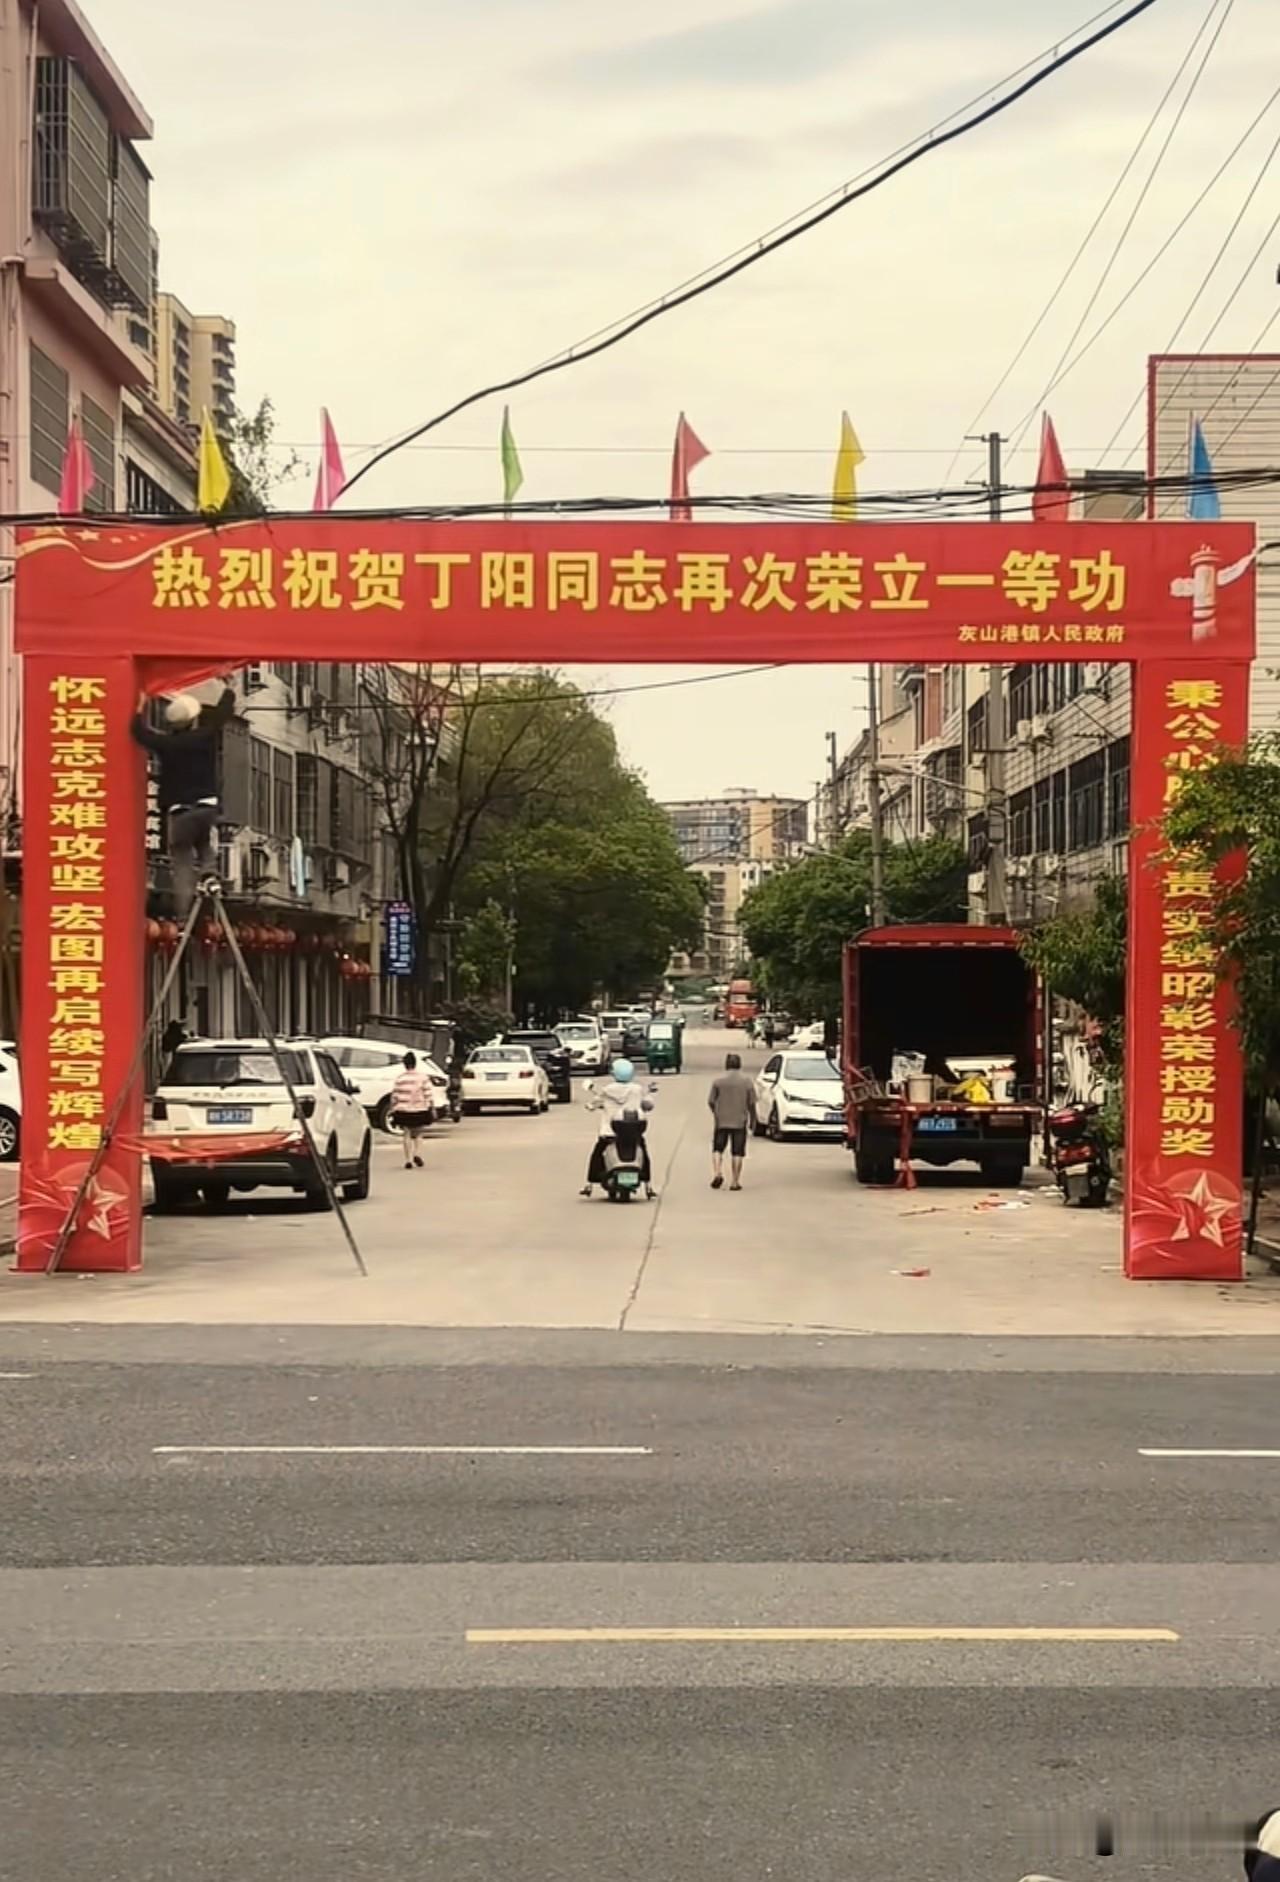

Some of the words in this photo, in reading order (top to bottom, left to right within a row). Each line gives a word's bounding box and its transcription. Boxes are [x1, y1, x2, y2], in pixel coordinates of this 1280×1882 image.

[152, 547, 1126, 613] 热烈祝贺丁阳同志再次荣立一等功
[958, 624, 1125, 642] 灰山港镇人民政府
[49, 676, 106, 892] 怀远志克难攻坚
[48, 902, 105, 1150] 宏图再启续写辉煌
